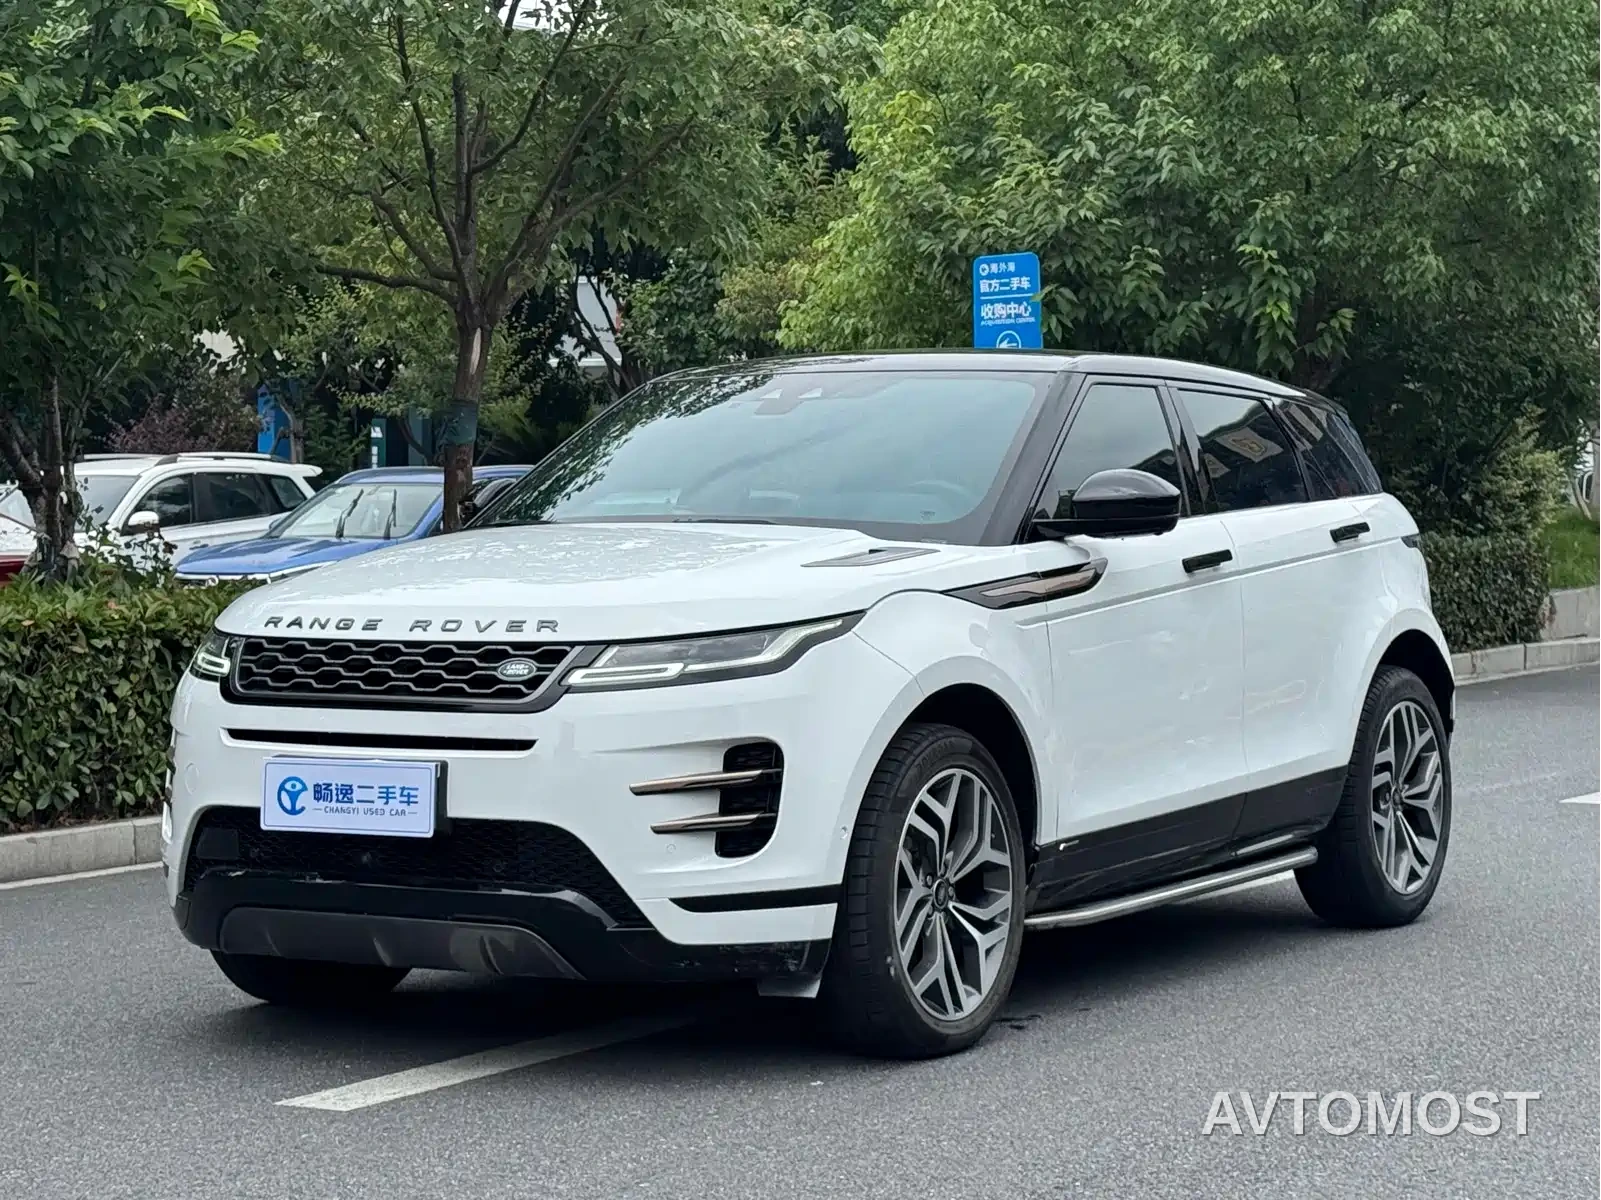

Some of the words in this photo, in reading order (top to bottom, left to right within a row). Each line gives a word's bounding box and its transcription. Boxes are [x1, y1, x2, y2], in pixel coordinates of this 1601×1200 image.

[980, 276, 1031, 293] 官方二手车
[981, 301, 1031, 319] 收购中心
[264, 616, 383, 632] RANGE
[408, 619, 559, 633] ROVER
[313, 782, 419, 806] 畅逸二手车
[324, 805, 359, 815] CHANGYI
[363, 807, 385, 816] USED
[389, 808, 406, 817] CAR
